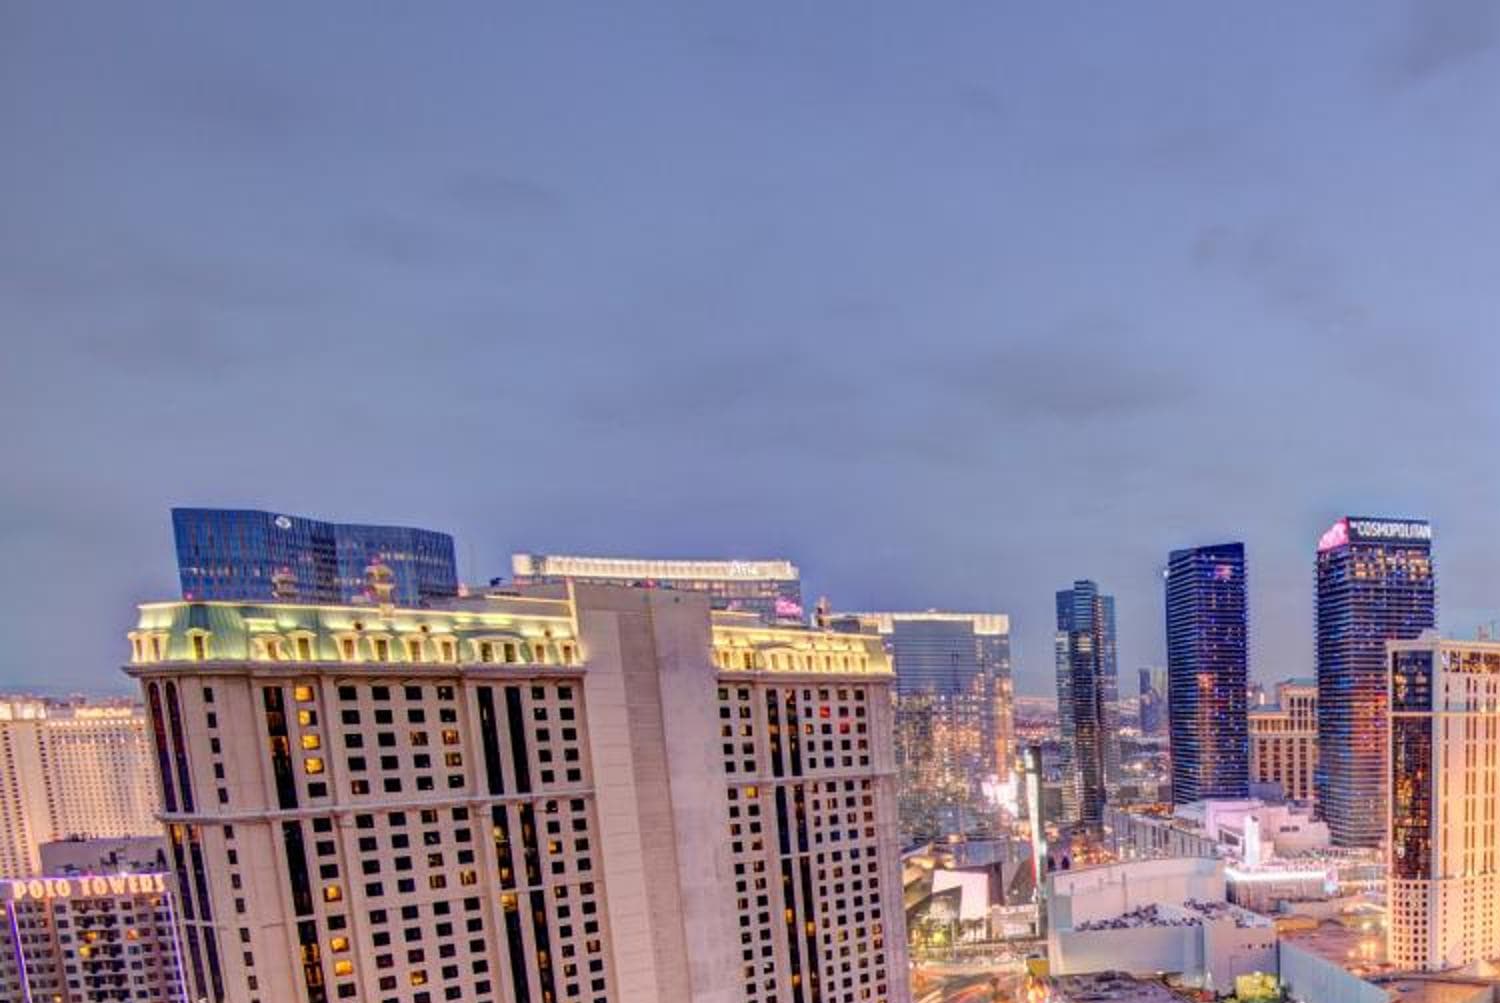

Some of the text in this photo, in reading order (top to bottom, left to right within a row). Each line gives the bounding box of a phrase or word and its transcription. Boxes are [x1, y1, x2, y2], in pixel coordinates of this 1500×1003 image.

[1357, 521, 1431, 539] COSMOPOLITAN
[13, 874, 166, 899] POLO TOWERS
